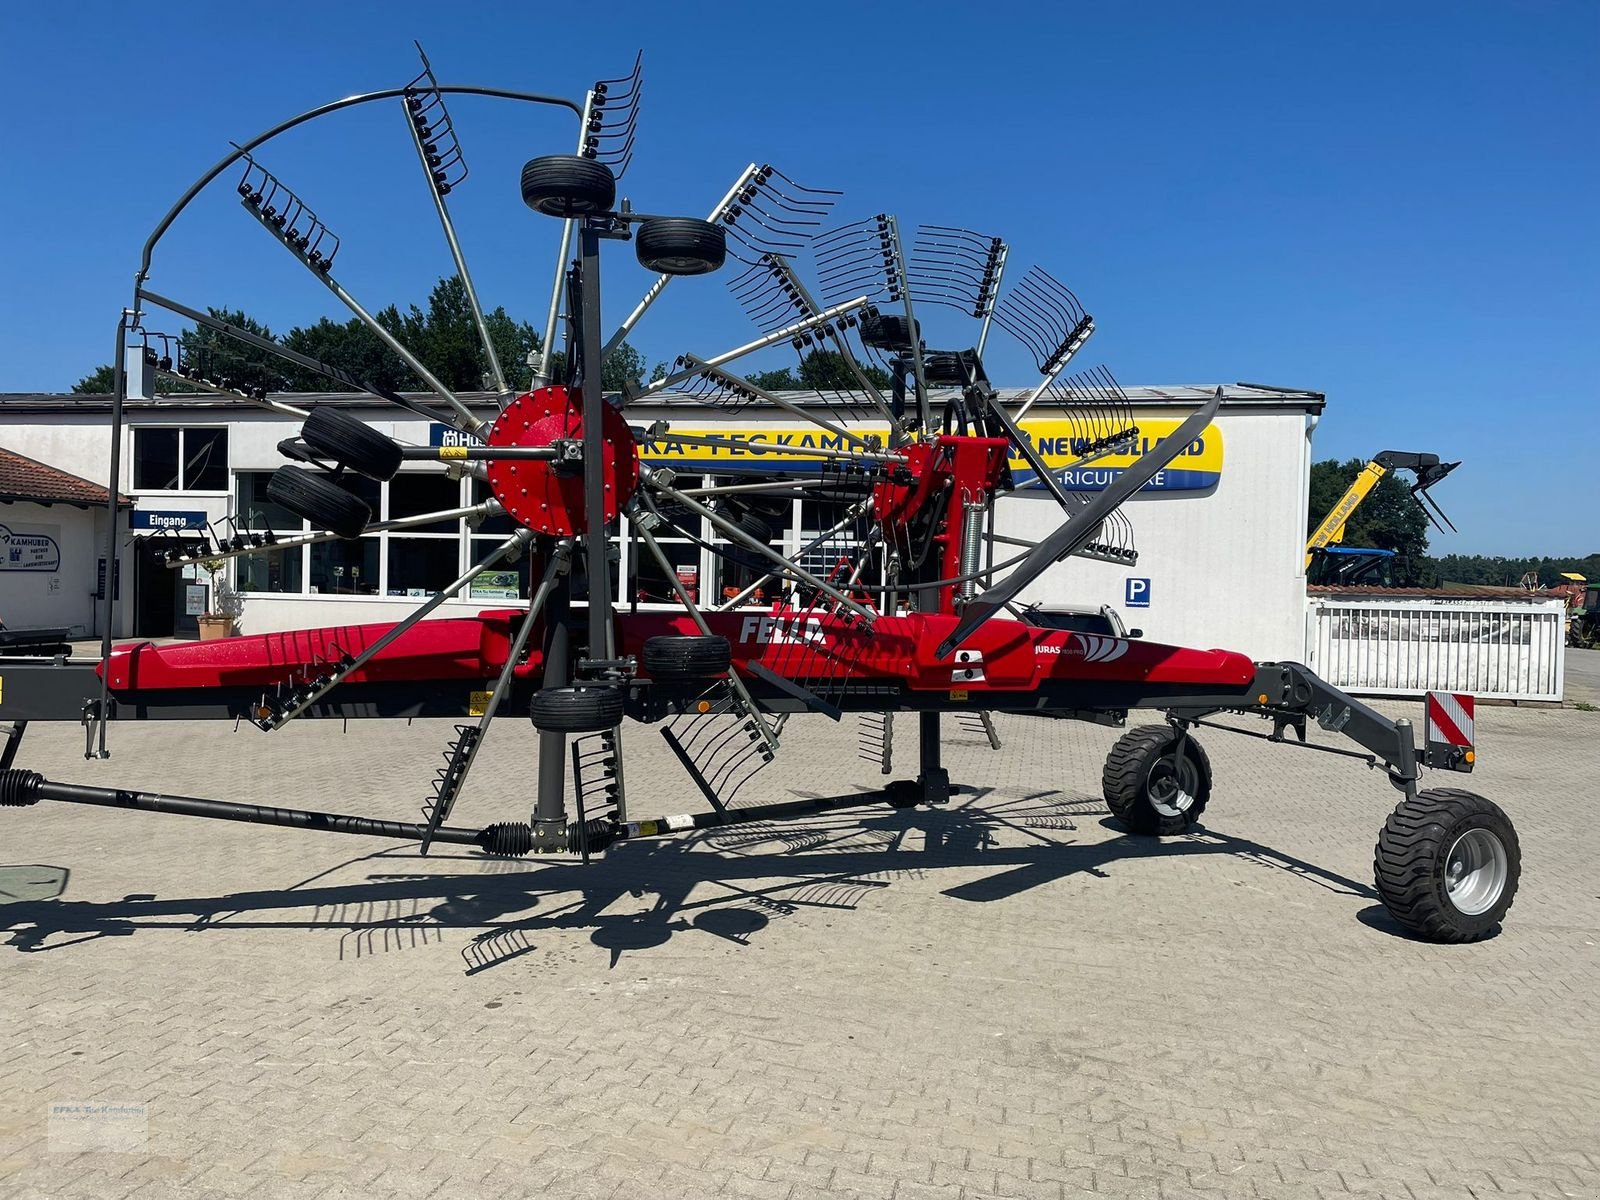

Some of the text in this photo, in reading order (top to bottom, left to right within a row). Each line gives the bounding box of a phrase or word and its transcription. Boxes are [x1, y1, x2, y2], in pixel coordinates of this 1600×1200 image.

[149, 514, 187, 526] Eingang
[10, 538, 50, 547] KAMHUBER
[1130, 579, 1146, 600] P
[738, 616, 827, 645] FELLA
[1034, 645, 1061, 655] JURAS
